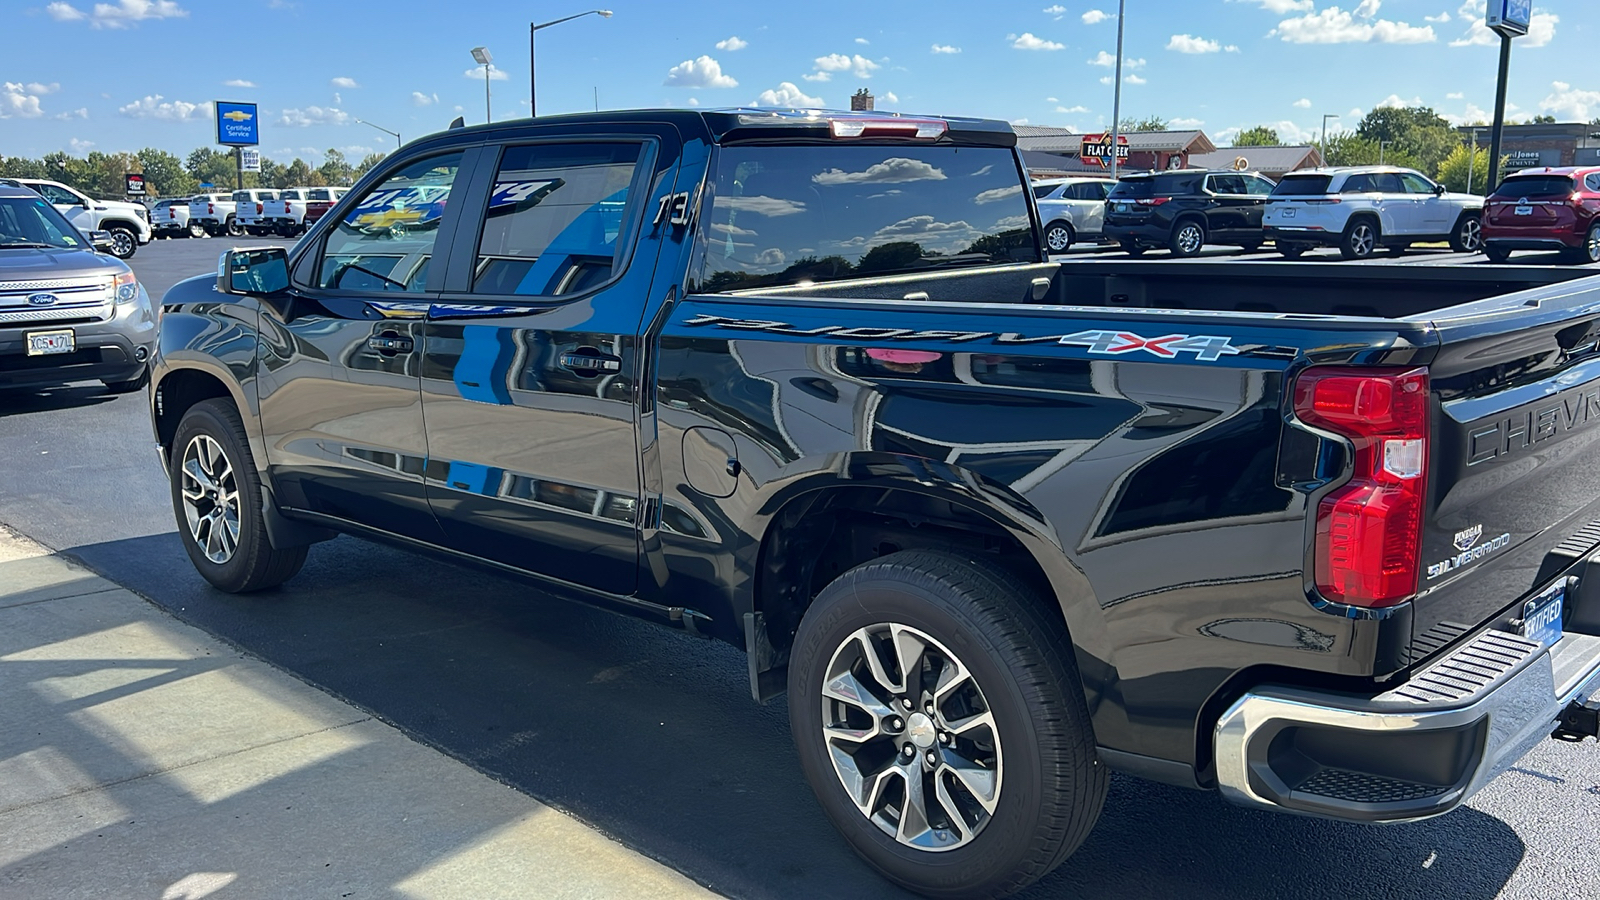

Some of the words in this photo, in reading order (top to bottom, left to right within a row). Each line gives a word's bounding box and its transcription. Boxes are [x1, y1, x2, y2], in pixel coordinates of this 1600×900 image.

[1087, 145, 1105, 156] FLAT
[1107, 146, 1129, 157] CEEK
[1516, 150, 1540, 159] Jones
[34, 295, 53, 303] Ford
[1454, 523, 1483, 543] PINEGAR
[1426, 532, 1510, 580] SILVERADO
[1524, 599, 1561, 639] ERTIFIED
